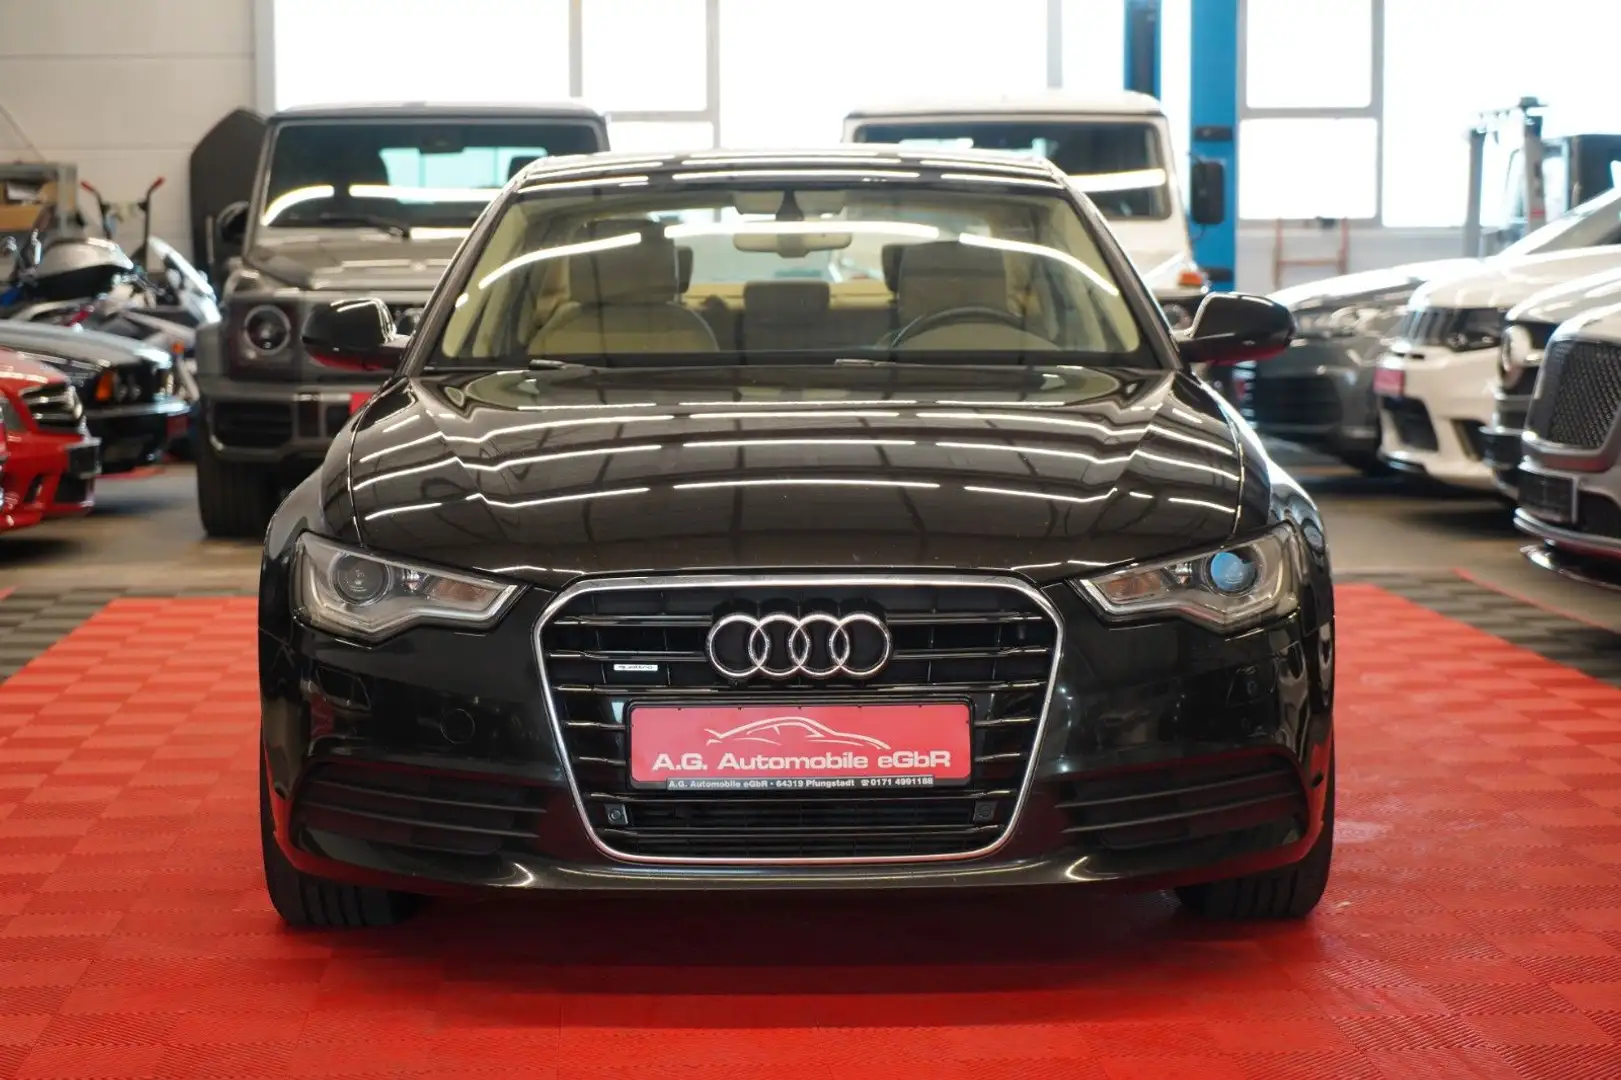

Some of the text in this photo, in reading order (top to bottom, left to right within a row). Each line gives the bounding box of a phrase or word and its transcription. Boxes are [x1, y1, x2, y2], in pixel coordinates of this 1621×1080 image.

[652, 750, 951, 770] A.G. Automobile eGbR
[668, 780, 688, 788] A.G.
[690, 780, 741, 788] Automobile
[743, 780, 768, 788] eGbR
[775, 780, 804, 788] 64319
[806, 779, 855, 788] Pfungstadt
[871, 778, 892, 786] 0171
